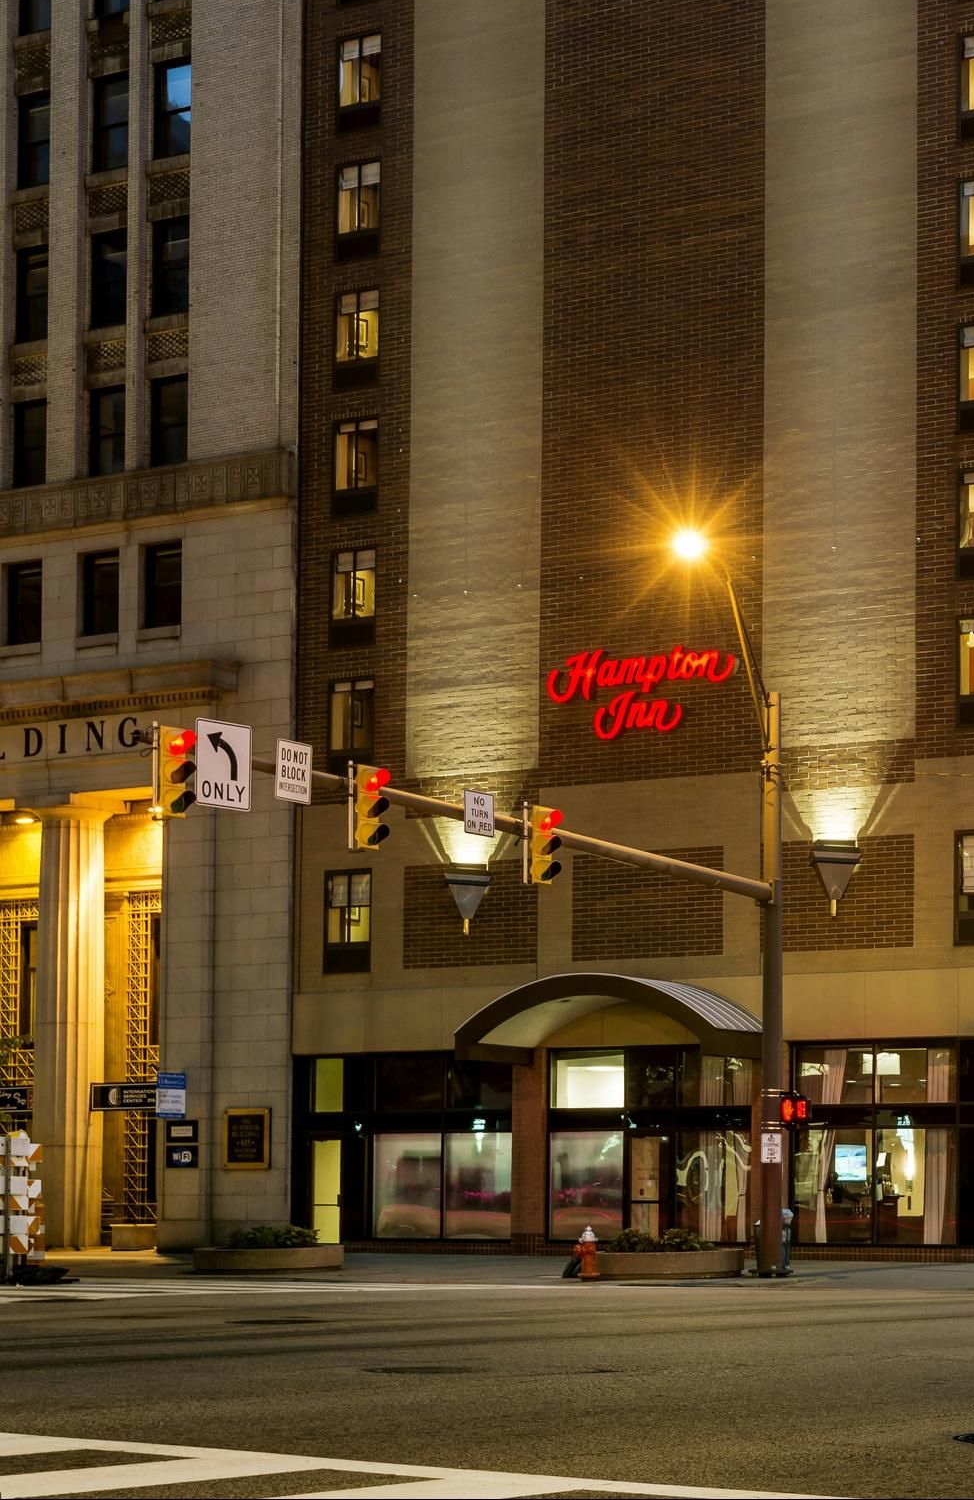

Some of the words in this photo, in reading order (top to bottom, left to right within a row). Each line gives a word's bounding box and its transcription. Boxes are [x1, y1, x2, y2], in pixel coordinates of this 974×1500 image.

[547, 645, 737, 703] Hampton
[593, 691, 682, 740] Inn
[0, 716, 140, 759] DING
[281, 748, 291, 762] DO
[293, 749, 308, 765] NOT
[281, 765, 306, 782] BLOCK
[202, 780, 245, 803] ONLY
[279, 781, 308, 795] INTERSECTION
[473, 796, 485, 806] NO
[471, 808, 488, 819] TURN
[467, 820, 476, 829] ON
[479, 822, 492, 831] RED
